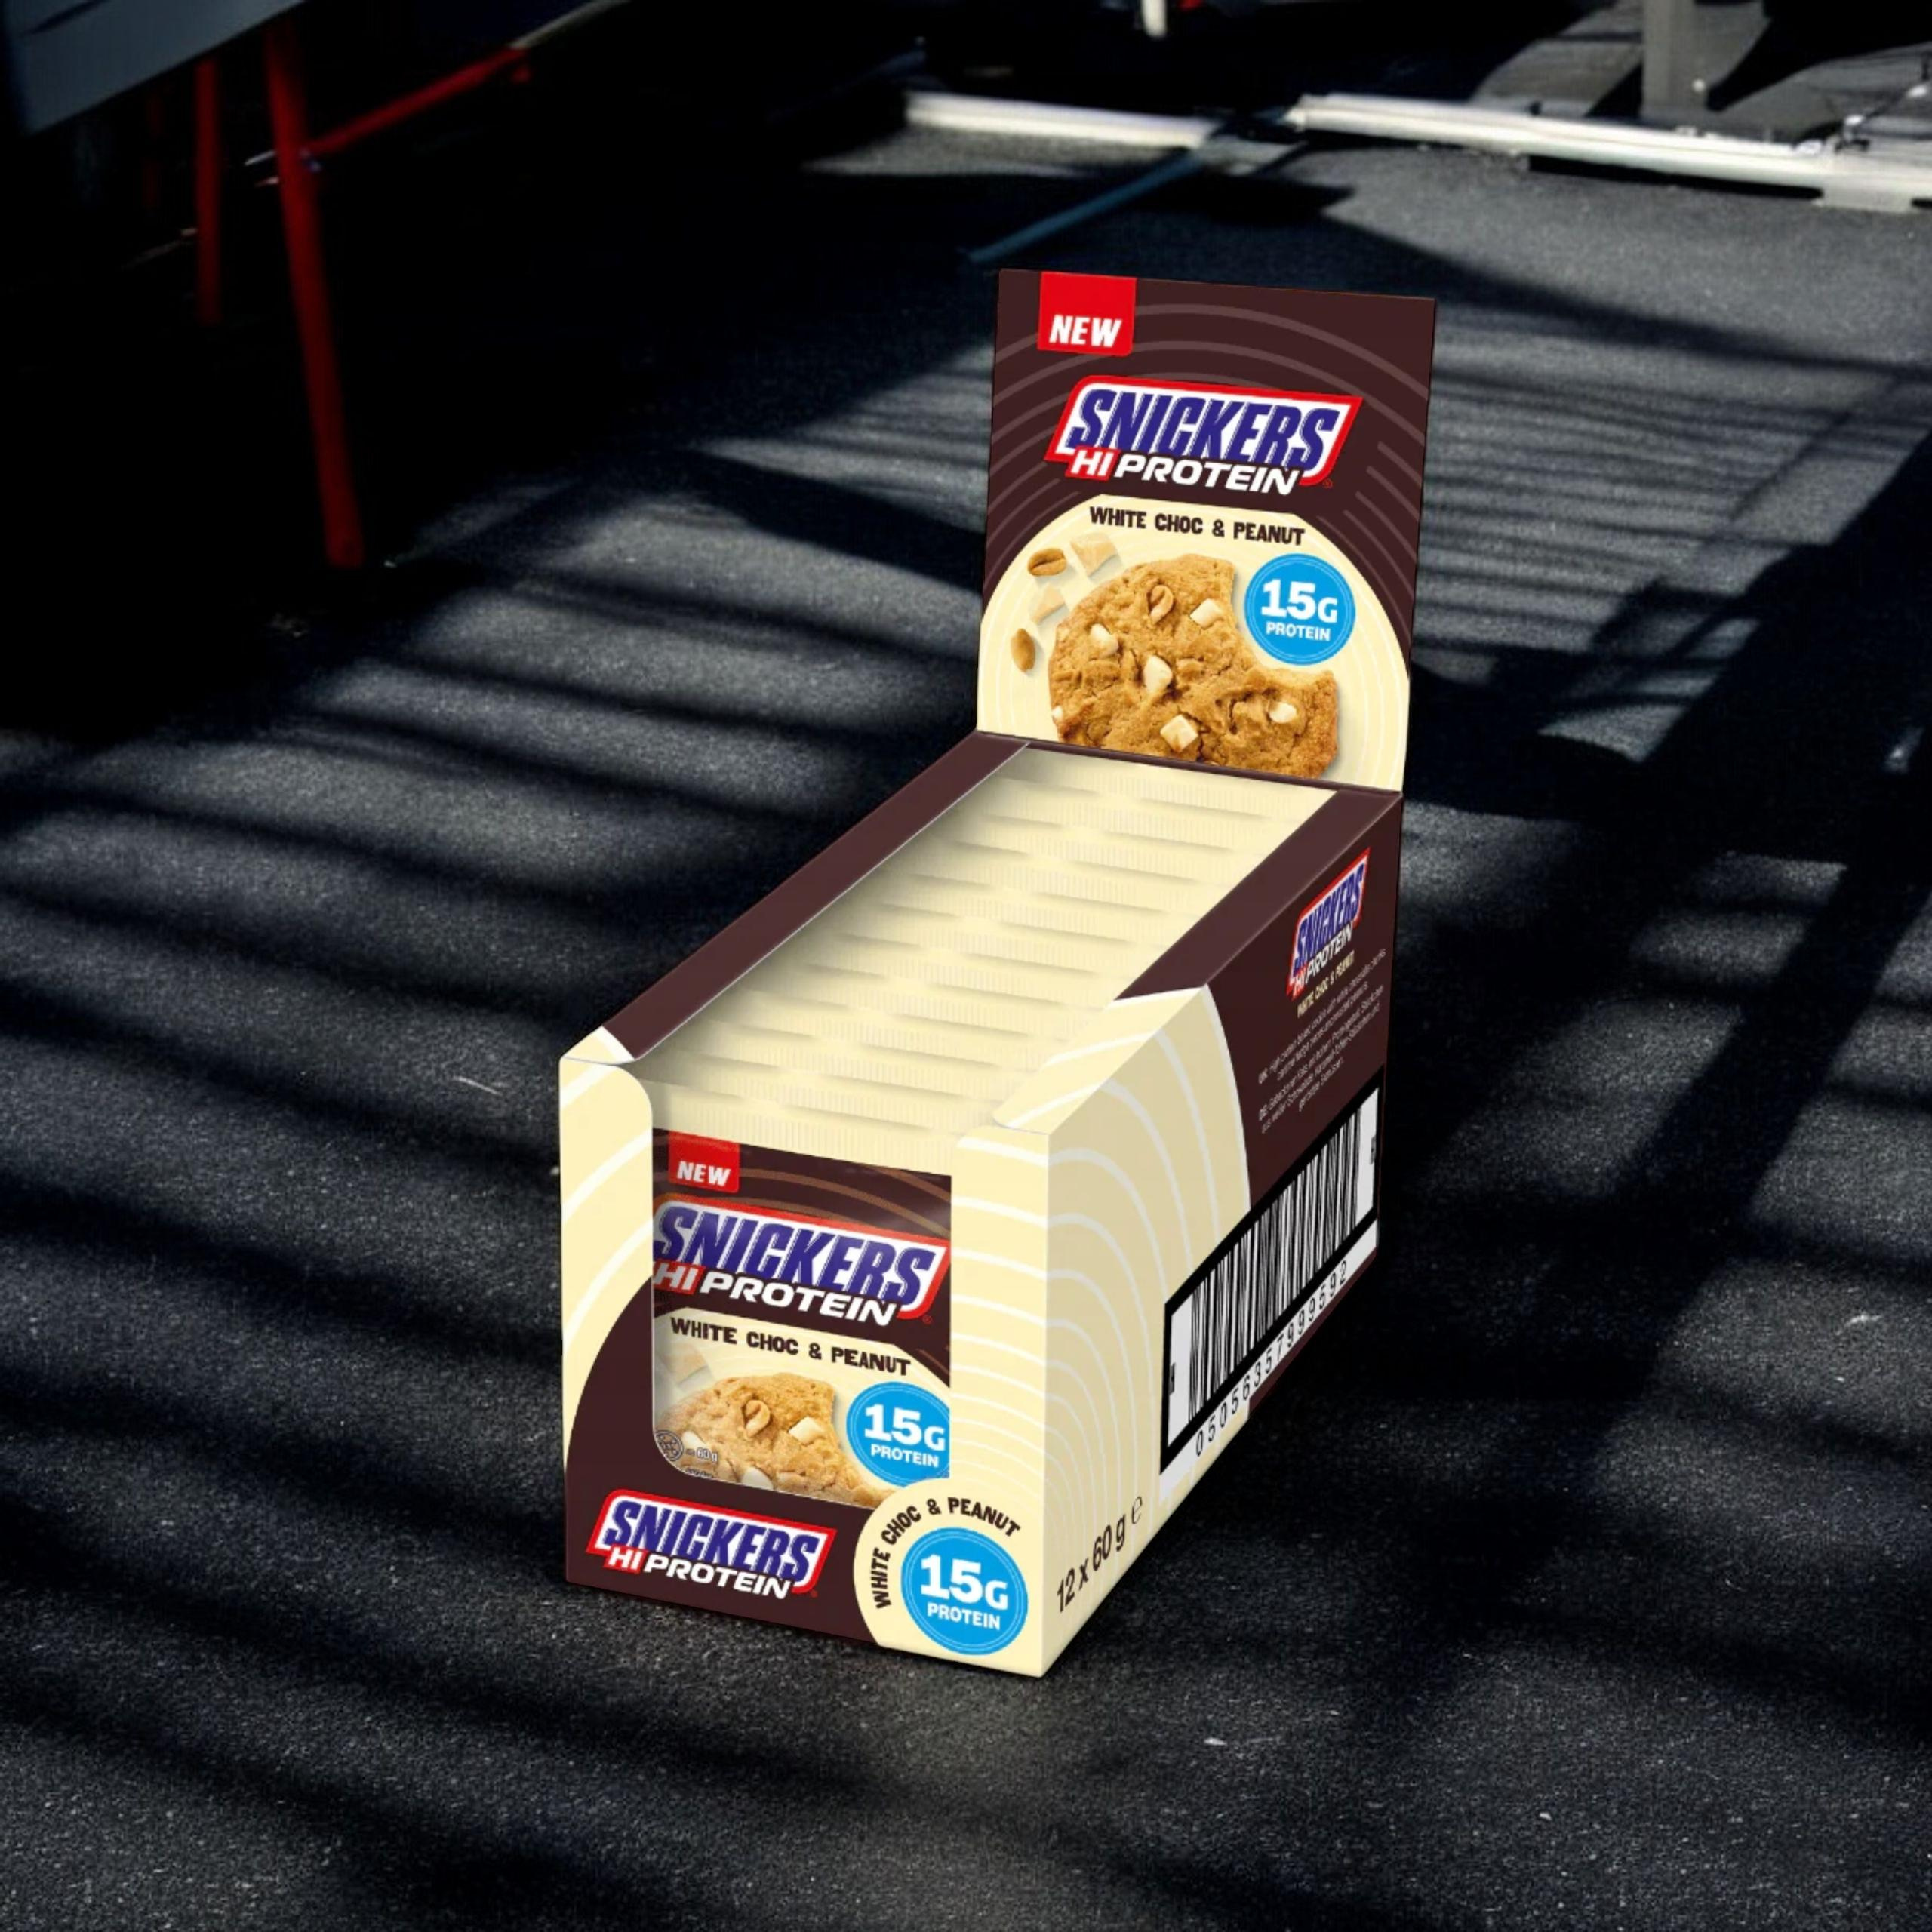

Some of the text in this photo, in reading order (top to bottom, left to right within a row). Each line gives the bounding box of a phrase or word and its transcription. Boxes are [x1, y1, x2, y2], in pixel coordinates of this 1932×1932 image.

[1049, 315, 1122, 348] NEW
[1066, 388, 1341, 472] SNICKERS
[1070, 453, 1300, 496] HI PROTEIN
[1089, 506, 1306, 546] WHITE CHOC & PEANUT
[1260, 578, 1338, 624] 15G
[1266, 622, 1331, 642] PROTEIN
[677, 1160, 731, 1187] NEW
[653, 1208, 937, 1306] SNICKERS
[653, 1262, 897, 1327] HI PROTEIN
[670, 1317, 912, 1376] WHITE CHOC & PEANUT
[864, 1404, 946, 1451] 15G
[870, 1443, 940, 1469] PROTEIN
[602, 1500, 820, 1583] SNICKERS
[870, 1497, 1021, 1610] WHITE CHOC & PEANUT
[1057, 1567, 1076, 1614] 12
[1078, 1557, 1089, 1592] x
[1092, 1524, 1113, 1572] 60
[1115, 1513, 1127, 1552] g
[608, 1547, 792, 1600] HI PROTEIN
[920, 1553, 1009, 1611] 15G
[927, 1602, 1001, 1631] PROTEIN
